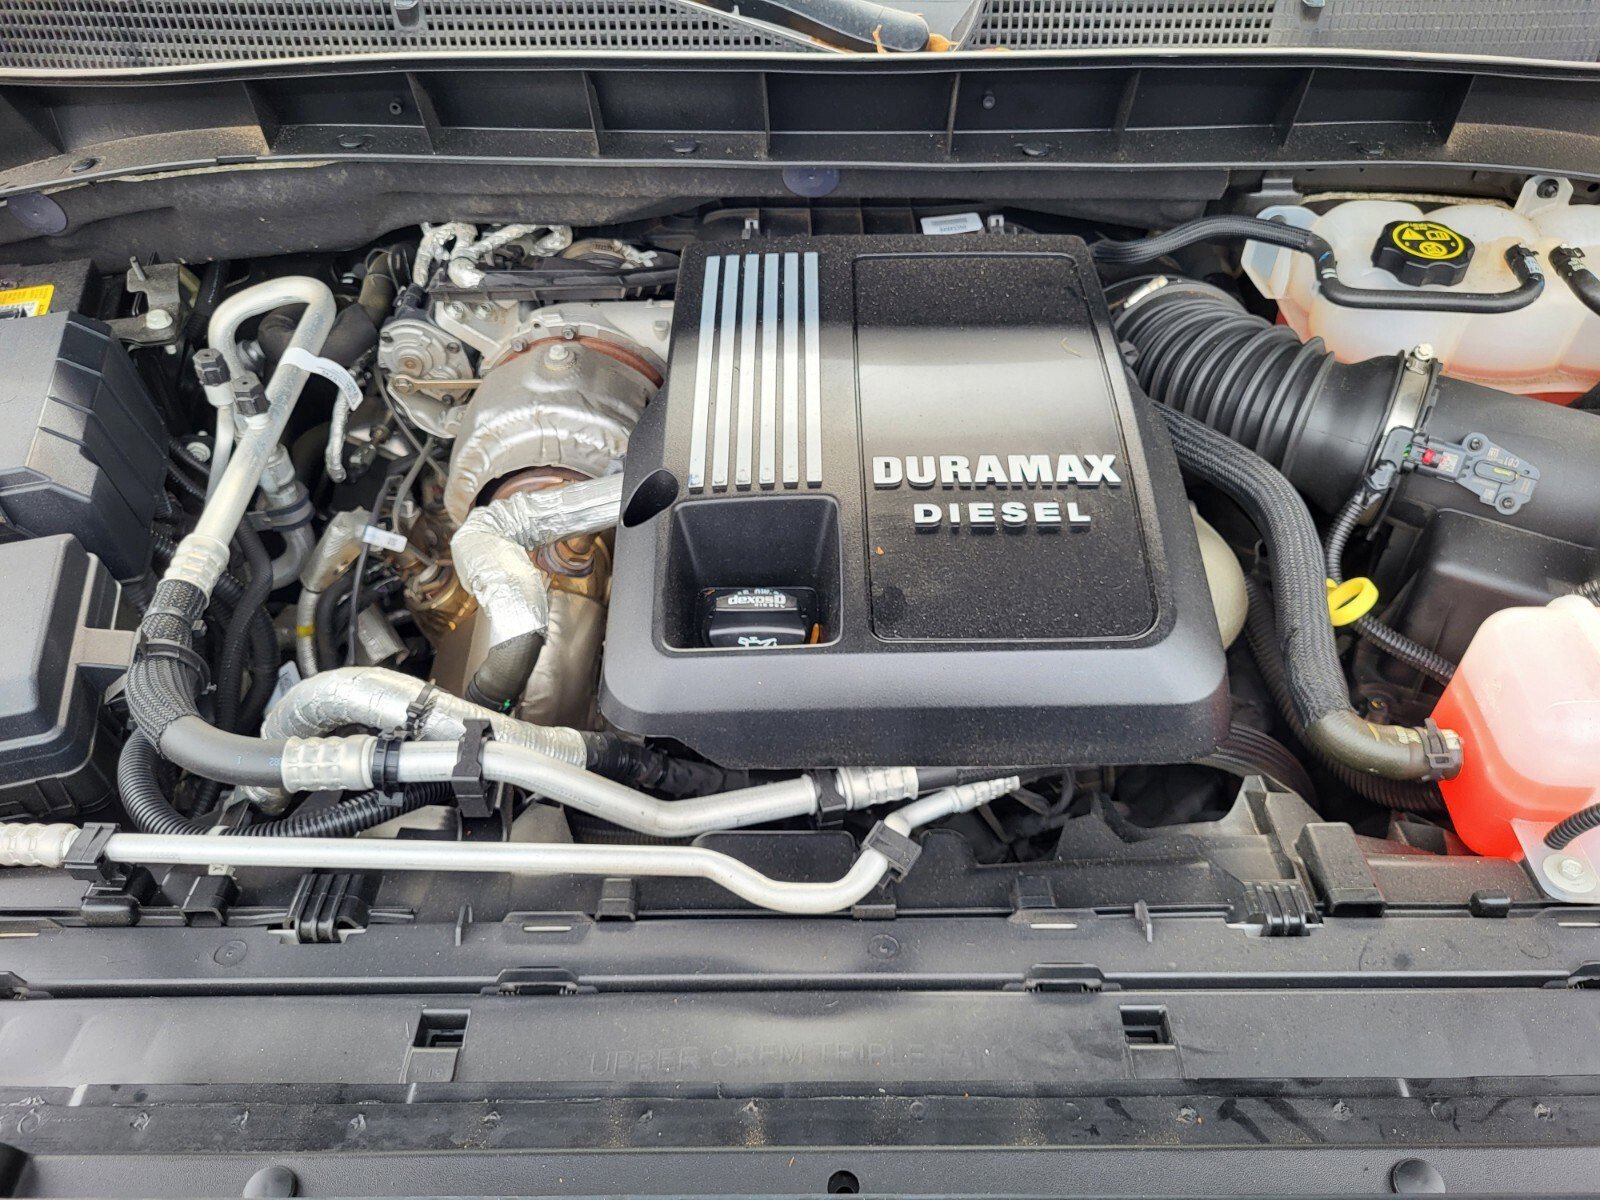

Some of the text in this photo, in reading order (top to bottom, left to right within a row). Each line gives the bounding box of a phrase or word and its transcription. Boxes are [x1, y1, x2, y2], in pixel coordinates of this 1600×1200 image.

[873, 454, 1121, 486] DURAMAX
[914, 502, 1091, 527] DIESEL
[589, 1046, 698, 1077] UPPER
[815, 1041, 927, 1068] TRIPLE
